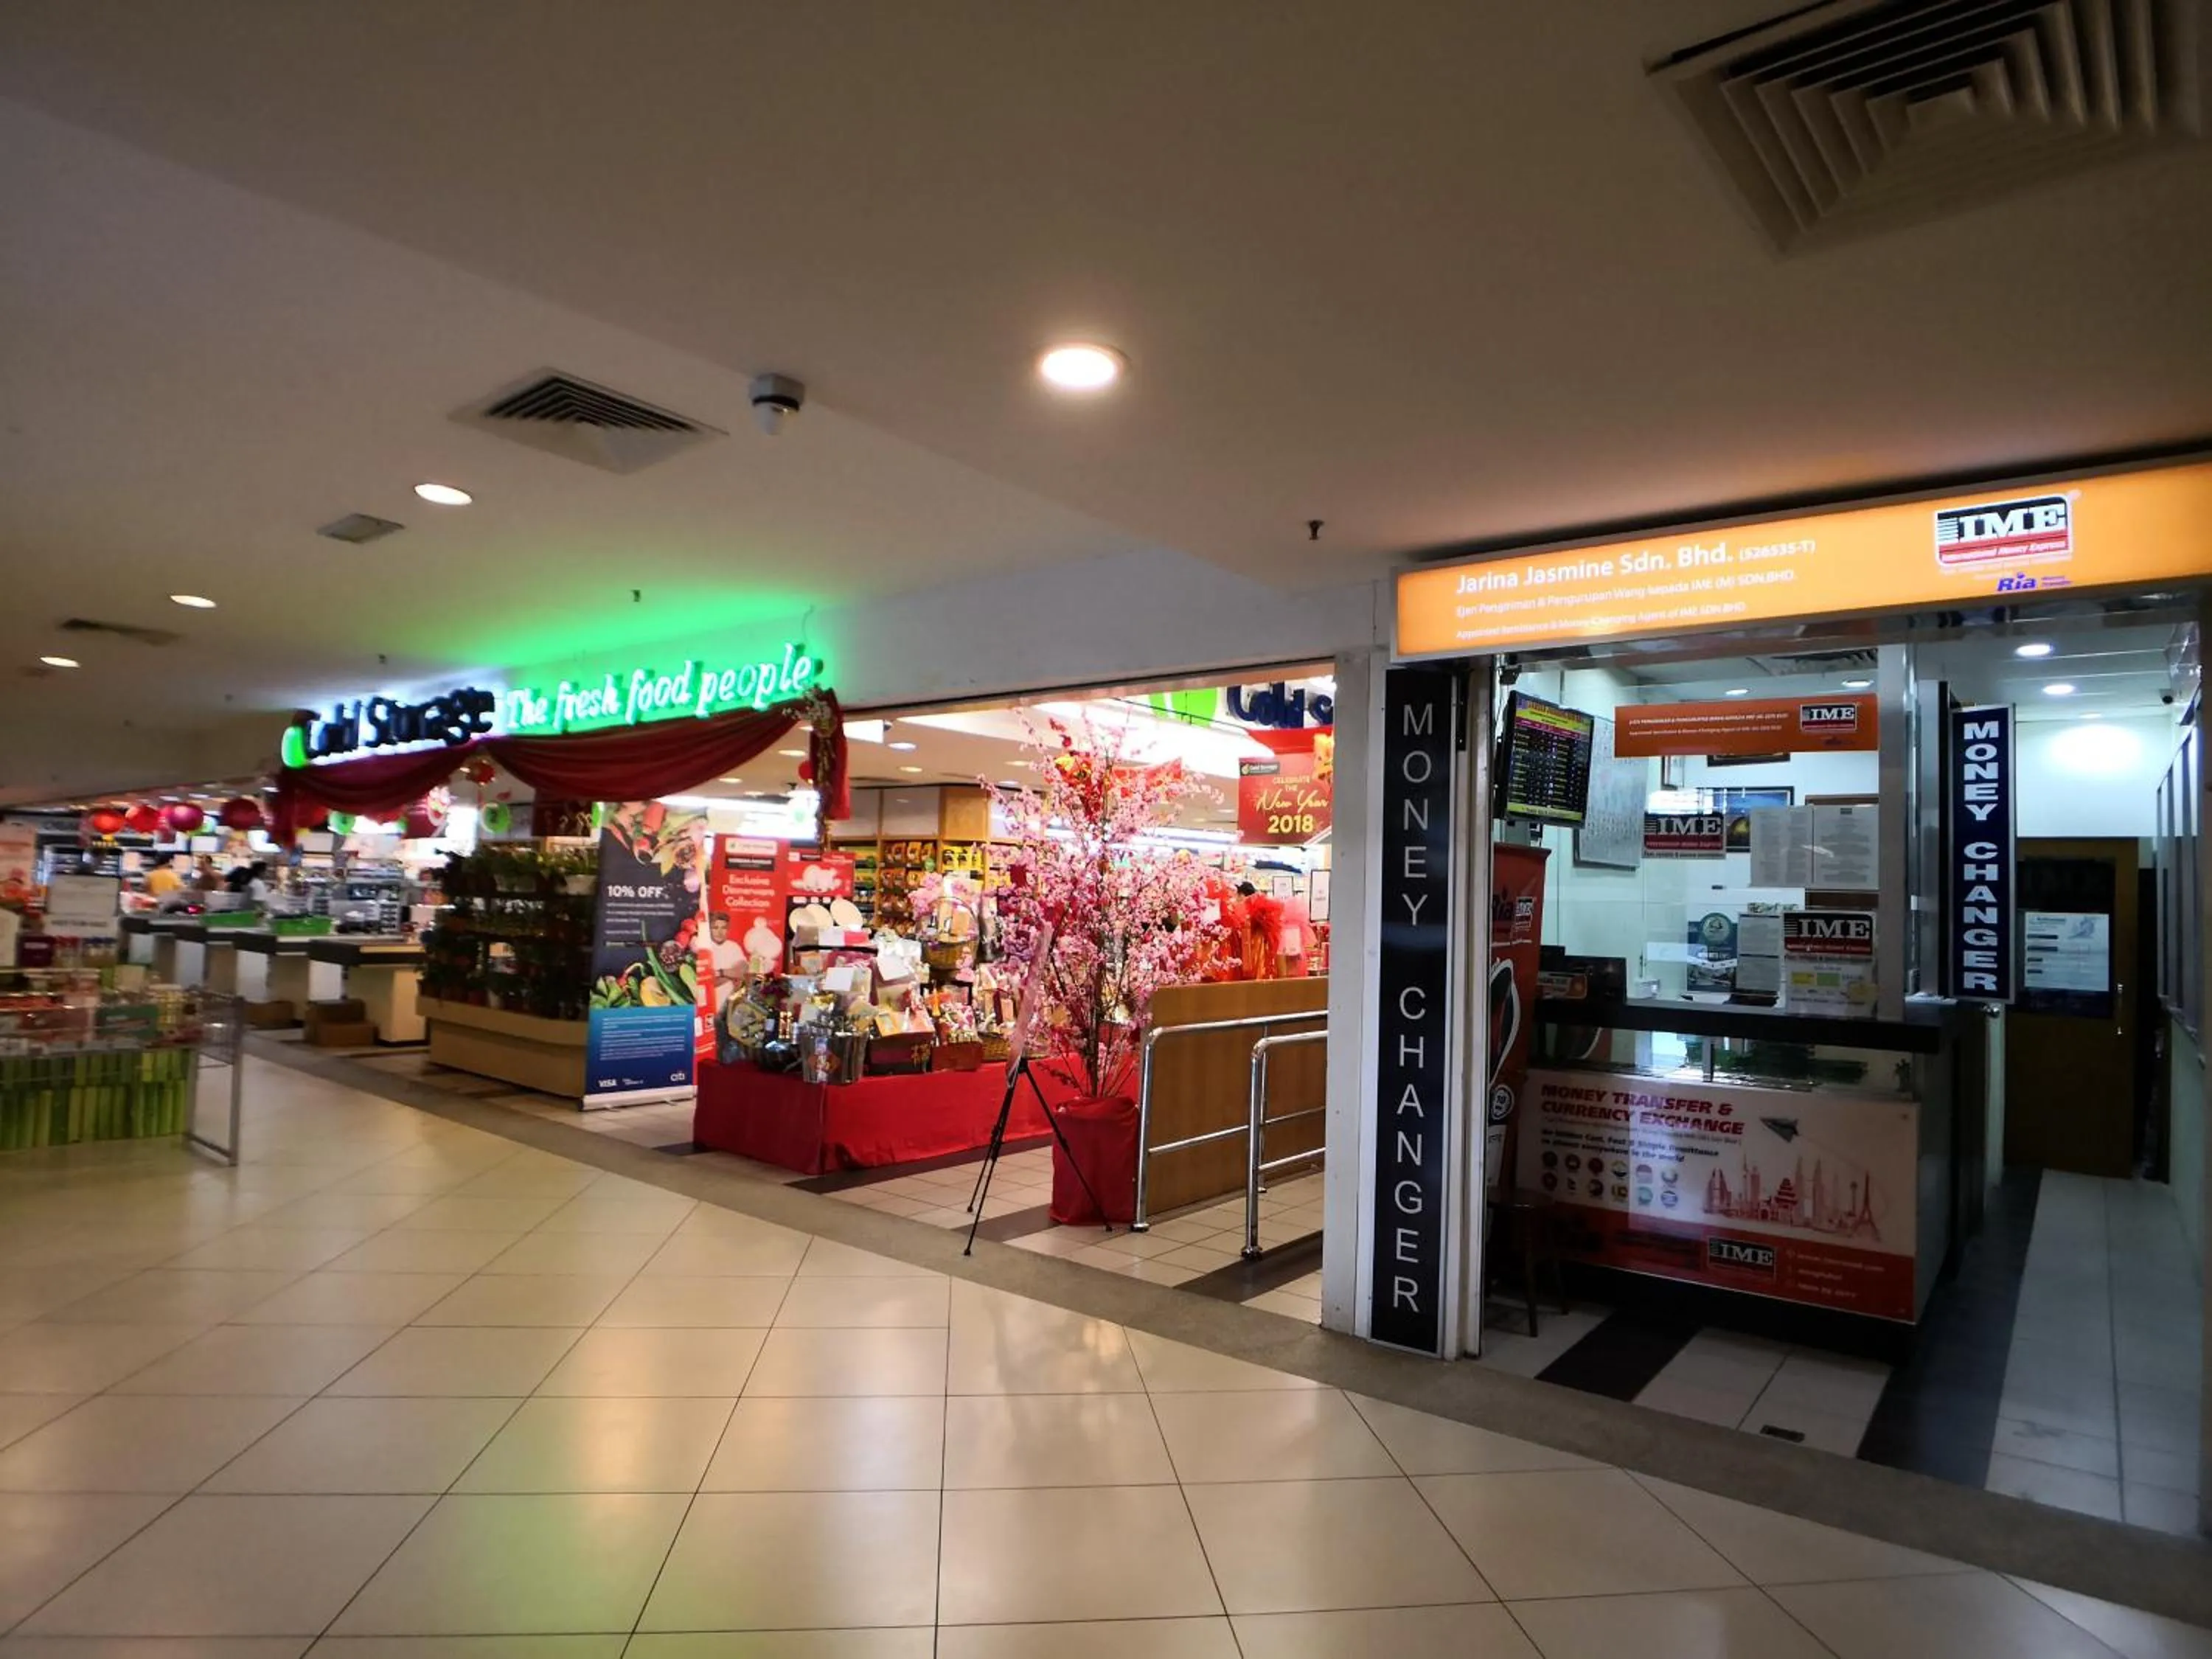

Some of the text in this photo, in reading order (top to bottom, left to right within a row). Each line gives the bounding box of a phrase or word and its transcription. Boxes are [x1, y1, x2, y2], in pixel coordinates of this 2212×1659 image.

[1958, 503, 2066, 540] IME
[1456, 571, 1518, 594] Jarina
[1523, 560, 1614, 585] Jasmine
[1619, 550, 1672, 573] Sdn.
[1677, 542, 1733, 567] Bhd.
[1997, 573, 2037, 592] Ria
[506, 642, 813, 731] The fresh food people
[1227, 681, 1304, 728] Cold
[1811, 707, 1855, 720] IME
[1964, 720, 1999, 821] MONEY
[1256, 788, 1329, 813] New Year
[1402, 703, 1434, 928] MONEY
[1267, 814, 1314, 833] 2018
[1657, 817, 1722, 835] IME
[607, 885, 635, 897] 10%
[1799, 918, 1871, 939] IME
[1964, 841, 1999, 992] CHANGER
[1541, 1084, 1733, 1116] MONEY TRANSFER &
[1541, 1101, 1635, 1121] CURRENCY
[1639, 1111, 1745, 1135] EXCHANGE
[1392, 986, 1427, 1314] CHANGER
[1721, 1243, 1773, 1267] IME
